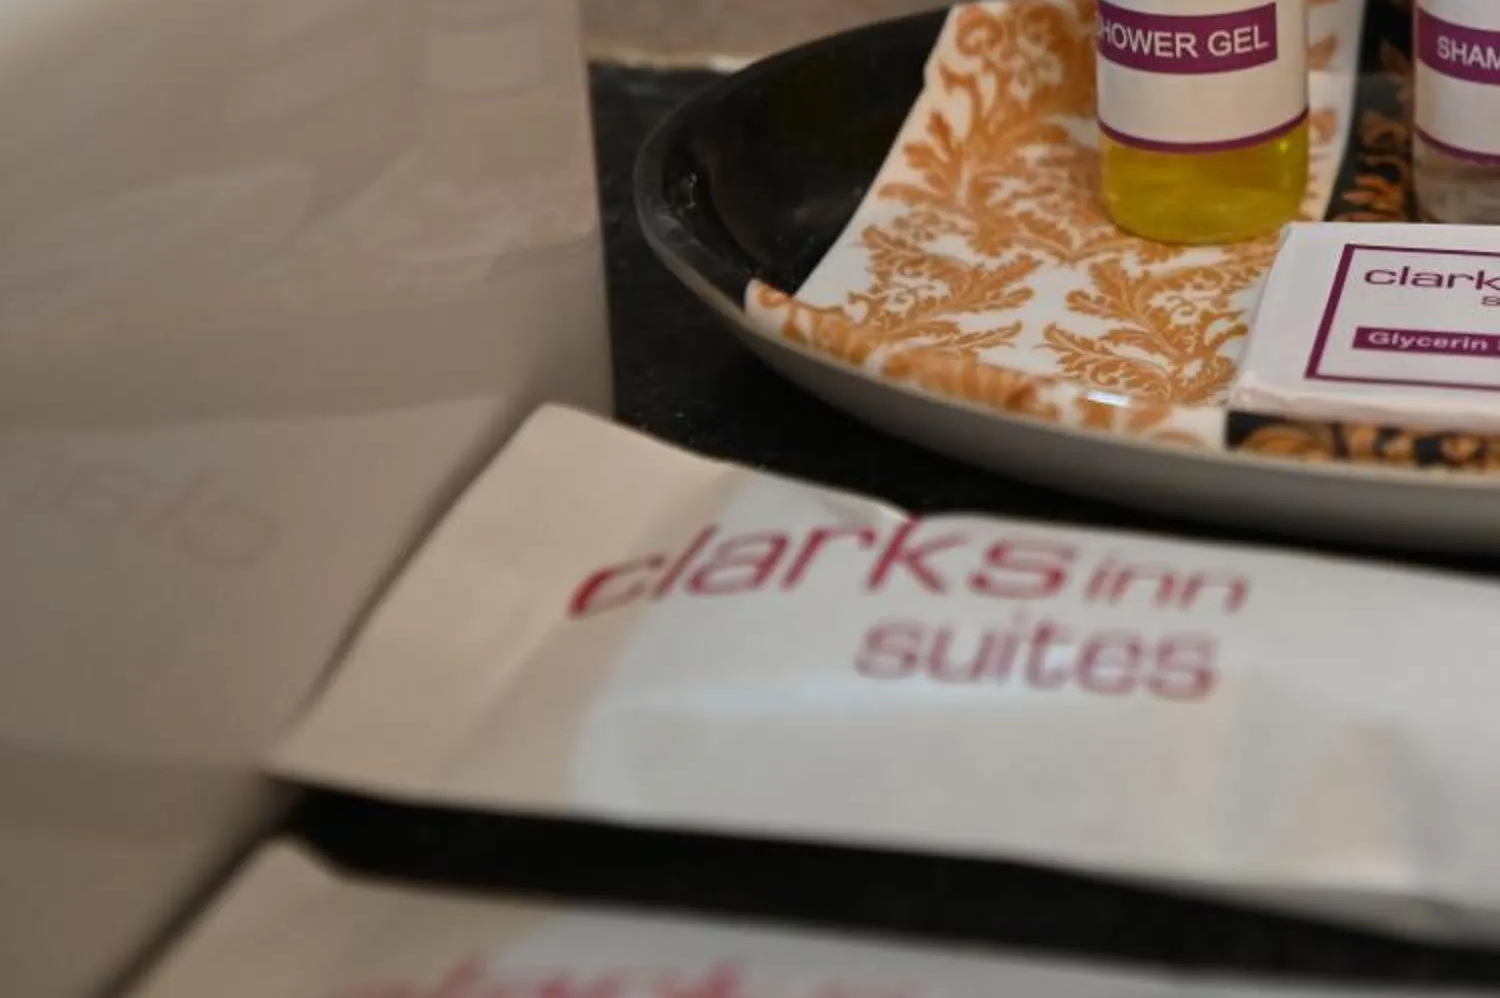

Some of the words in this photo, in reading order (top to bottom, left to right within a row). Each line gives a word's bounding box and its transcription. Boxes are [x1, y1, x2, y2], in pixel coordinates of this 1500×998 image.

[1099, 19, 1198, 58] HOWER
[1207, 24, 1270, 58] GEL
[1367, 330, 1490, 354] Glycerin
[570, 514, 1080, 616] clarks
[1083, 554, 1250, 614] inn
[854, 608, 1220, 702] suites
